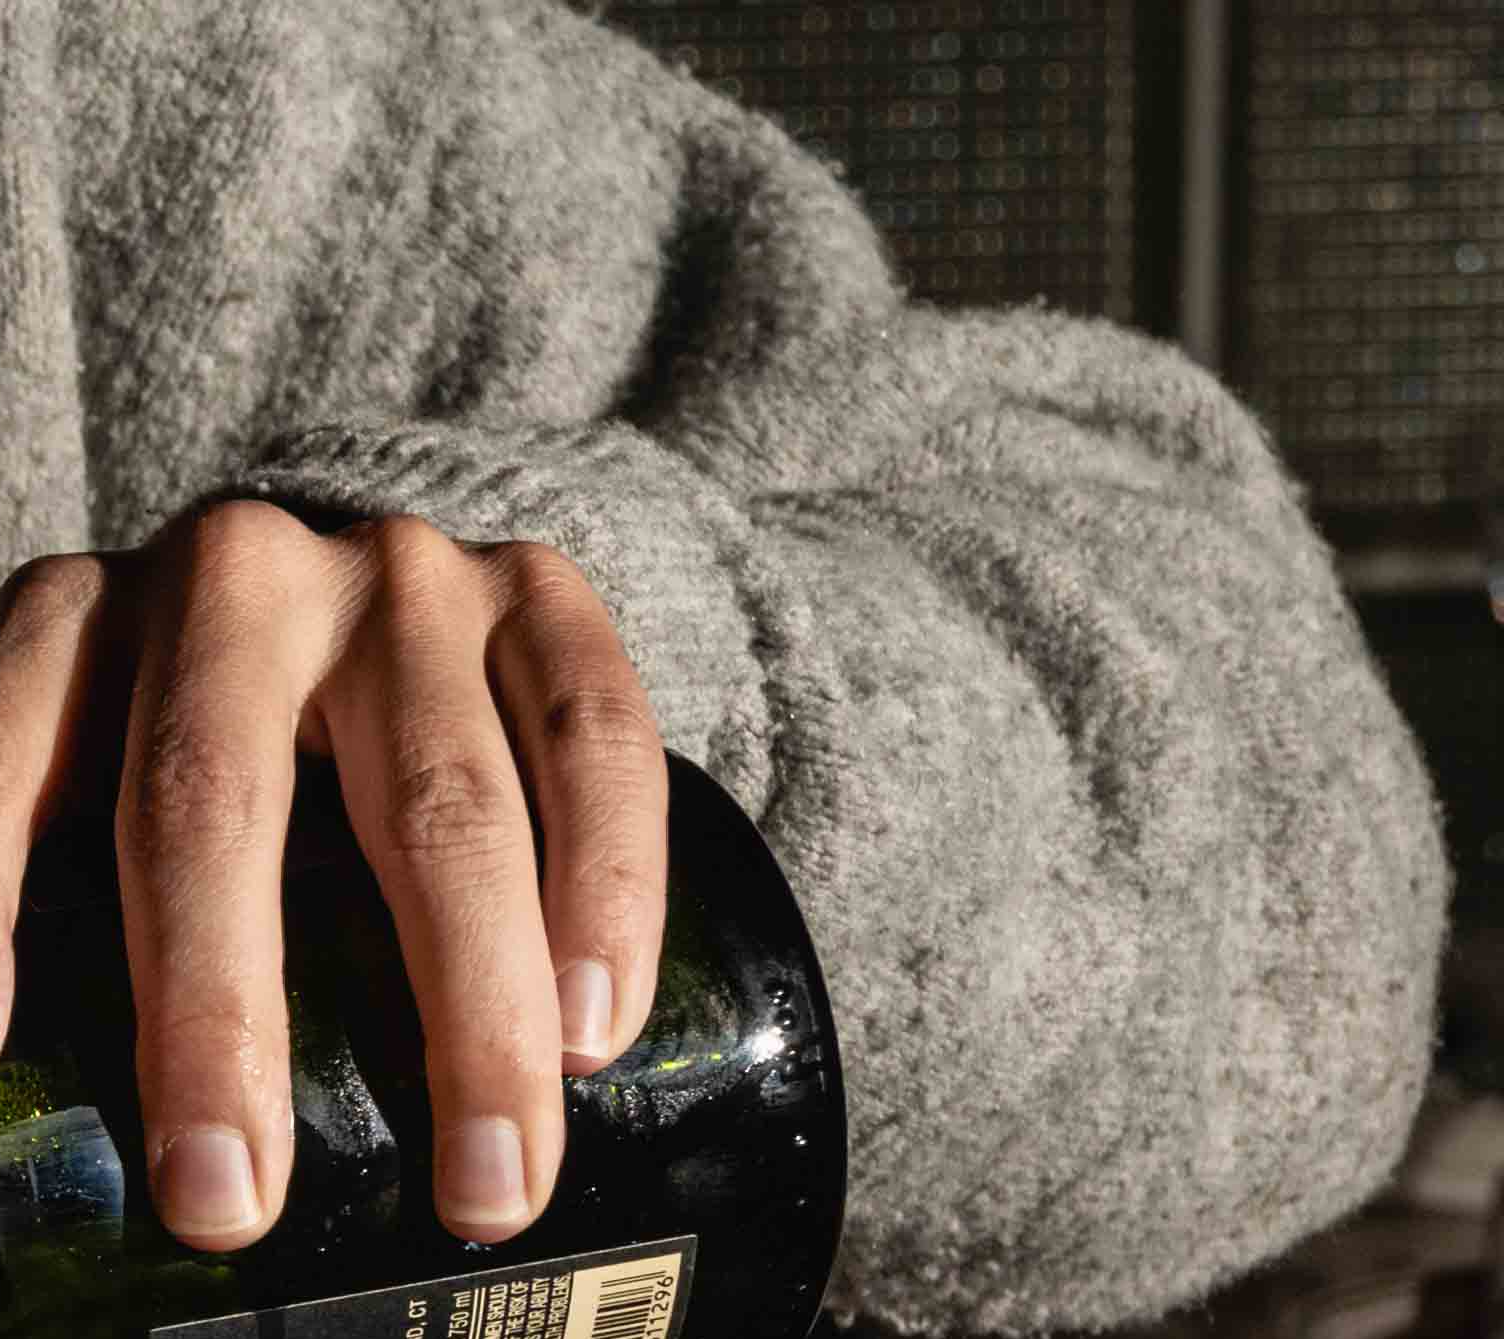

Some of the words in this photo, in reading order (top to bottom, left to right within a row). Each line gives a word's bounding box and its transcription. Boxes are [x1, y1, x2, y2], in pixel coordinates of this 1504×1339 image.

[453, 1290, 470, 1307] ml
[487, 1284, 507, 1320] SHOULD
[530, 1277, 549, 1308] ABILITY
[408, 1300, 426, 1318] CT
[447, 1311, 469, 1337] 750
